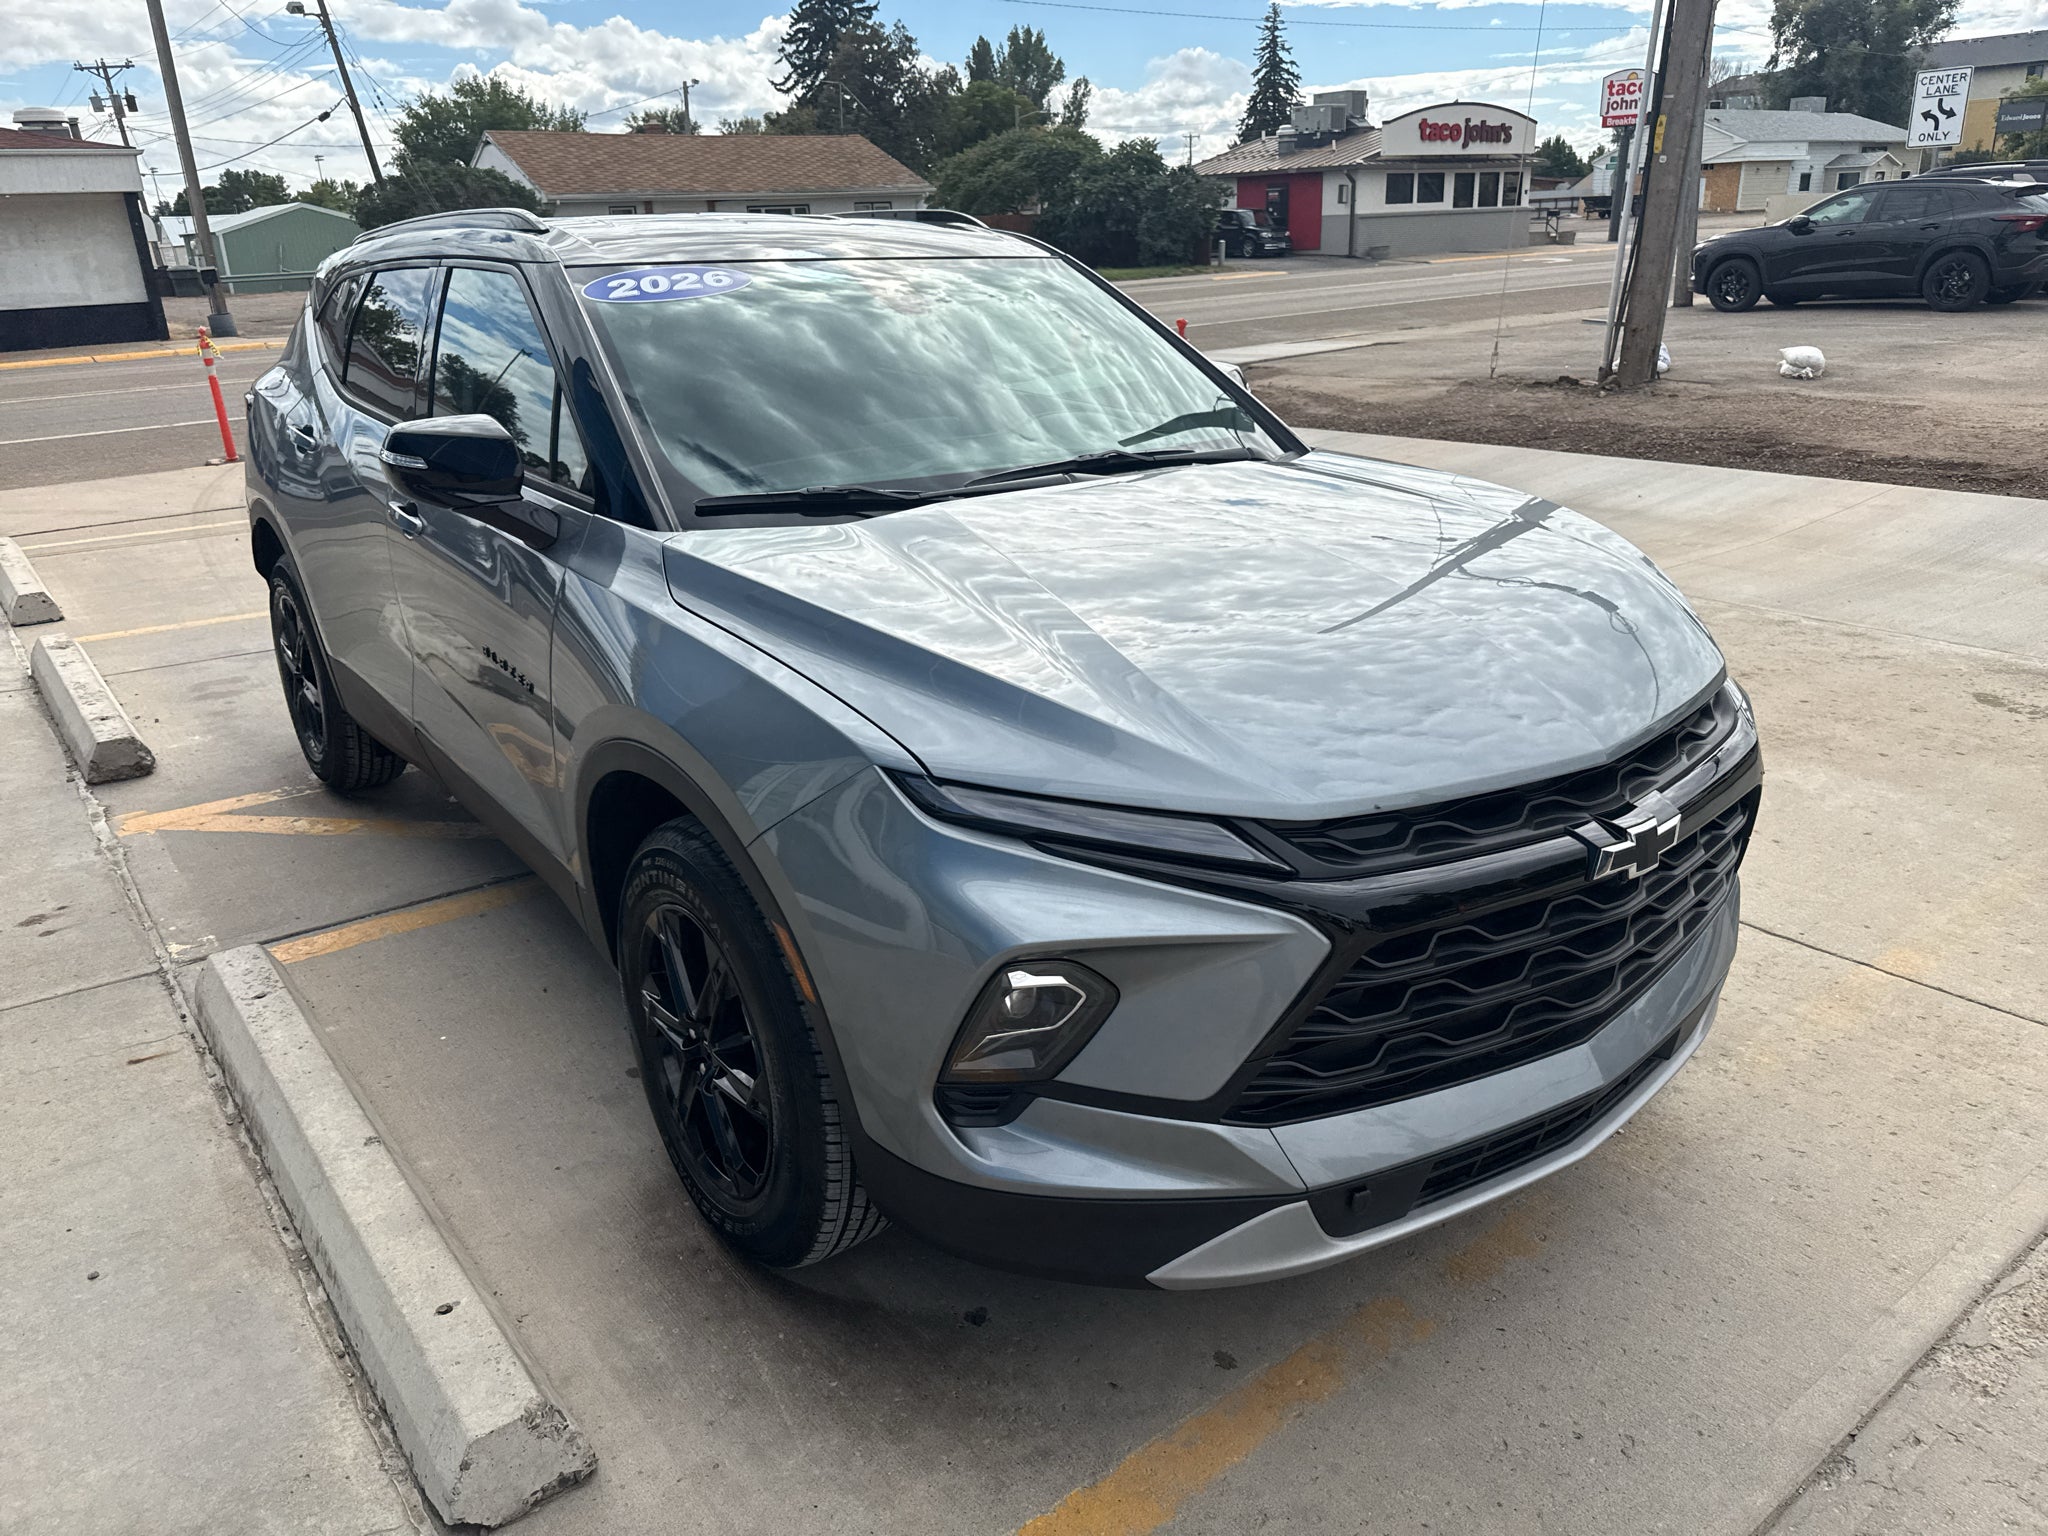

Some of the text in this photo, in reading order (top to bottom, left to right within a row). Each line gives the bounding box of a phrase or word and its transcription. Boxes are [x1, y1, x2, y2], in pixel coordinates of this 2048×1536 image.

[1920, 73, 1968, 86] CENTER
[1926, 84, 1959, 96] LANE
[1605, 97, 1640, 115] john'
[1607, 117, 1637, 126] Breakfa
[1419, 118, 1512, 149] taco john's
[1918, 131, 1951, 143] ONLY
[607, 271, 734, 299] 2026
